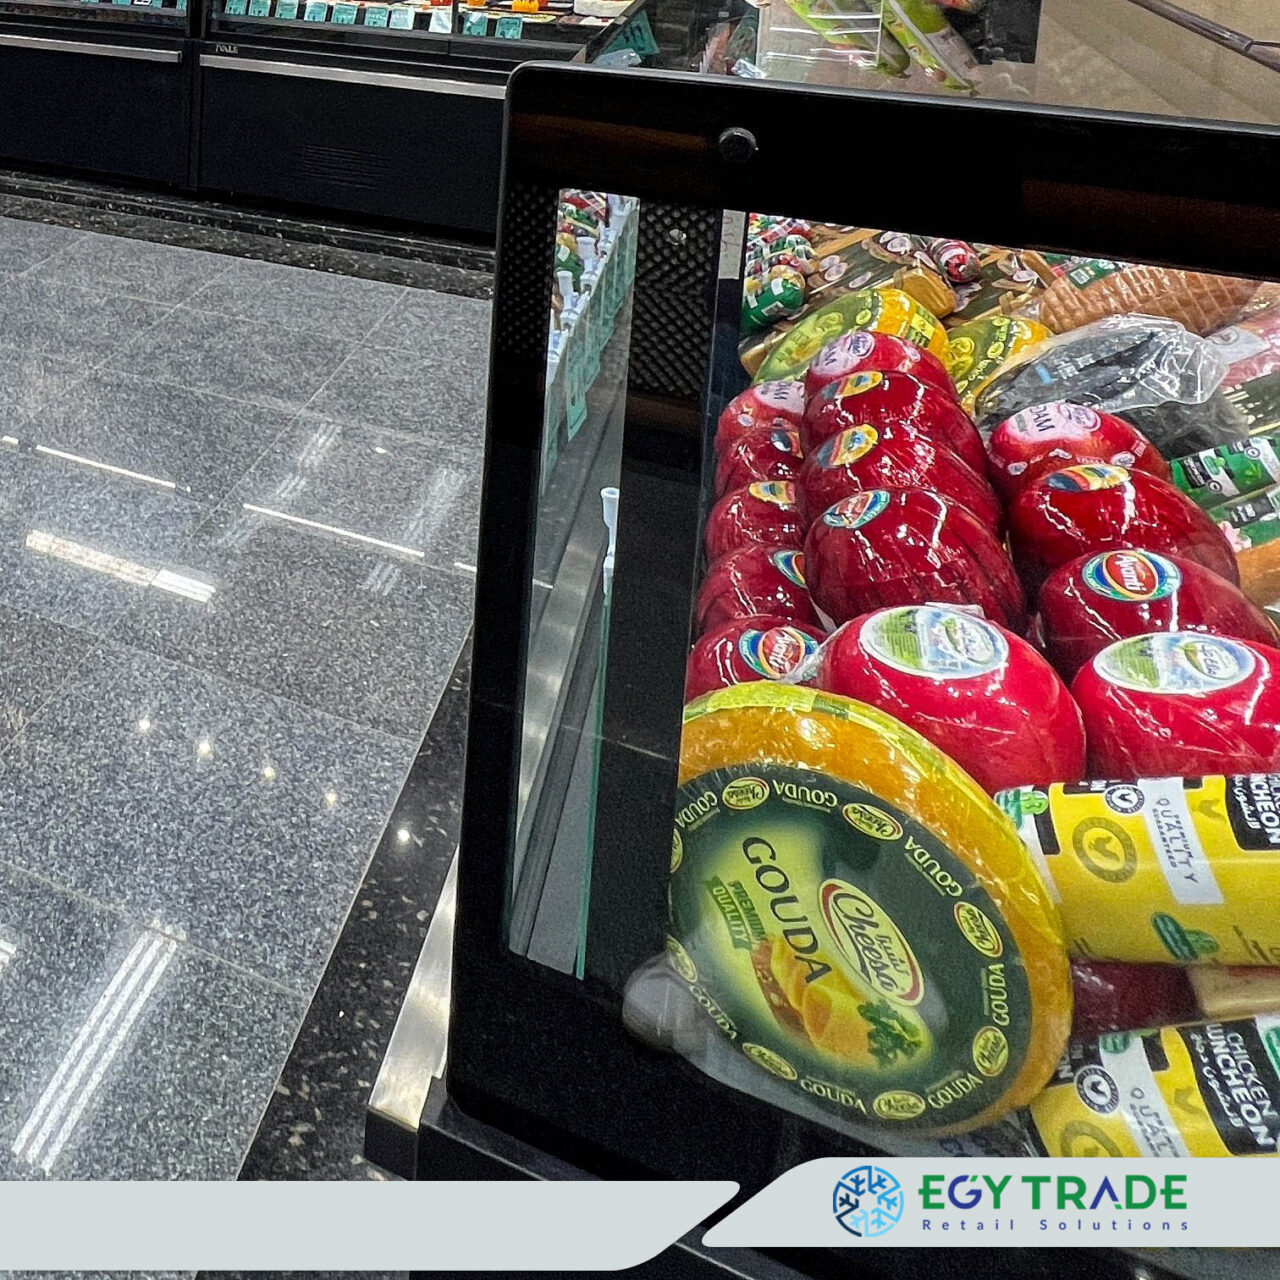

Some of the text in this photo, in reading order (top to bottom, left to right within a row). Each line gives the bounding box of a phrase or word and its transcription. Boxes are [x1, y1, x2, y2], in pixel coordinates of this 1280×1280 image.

[1029, 405, 1055, 432] DAM
[1115, 554, 1147, 592] Avanti
[674, 791, 718, 829] GOUDA
[772, 780, 838, 807] GOUDA
[904, 836, 963, 897] GOUDA
[1155, 798, 1198, 883] QUALITY
[712, 887, 750, 948] QUALITY
[728, 881, 765, 940] PREMIUM
[742, 837, 832, 983] GOUDA
[832, 892, 900, 993] Cheesa
[989, 963, 1010, 1026] GOUDA
[800, 1079, 867, 1115] GOUDA
[927, 1072, 983, 1109] GOUDA
[1226, 1032, 1279, 1118] CHICKEN
